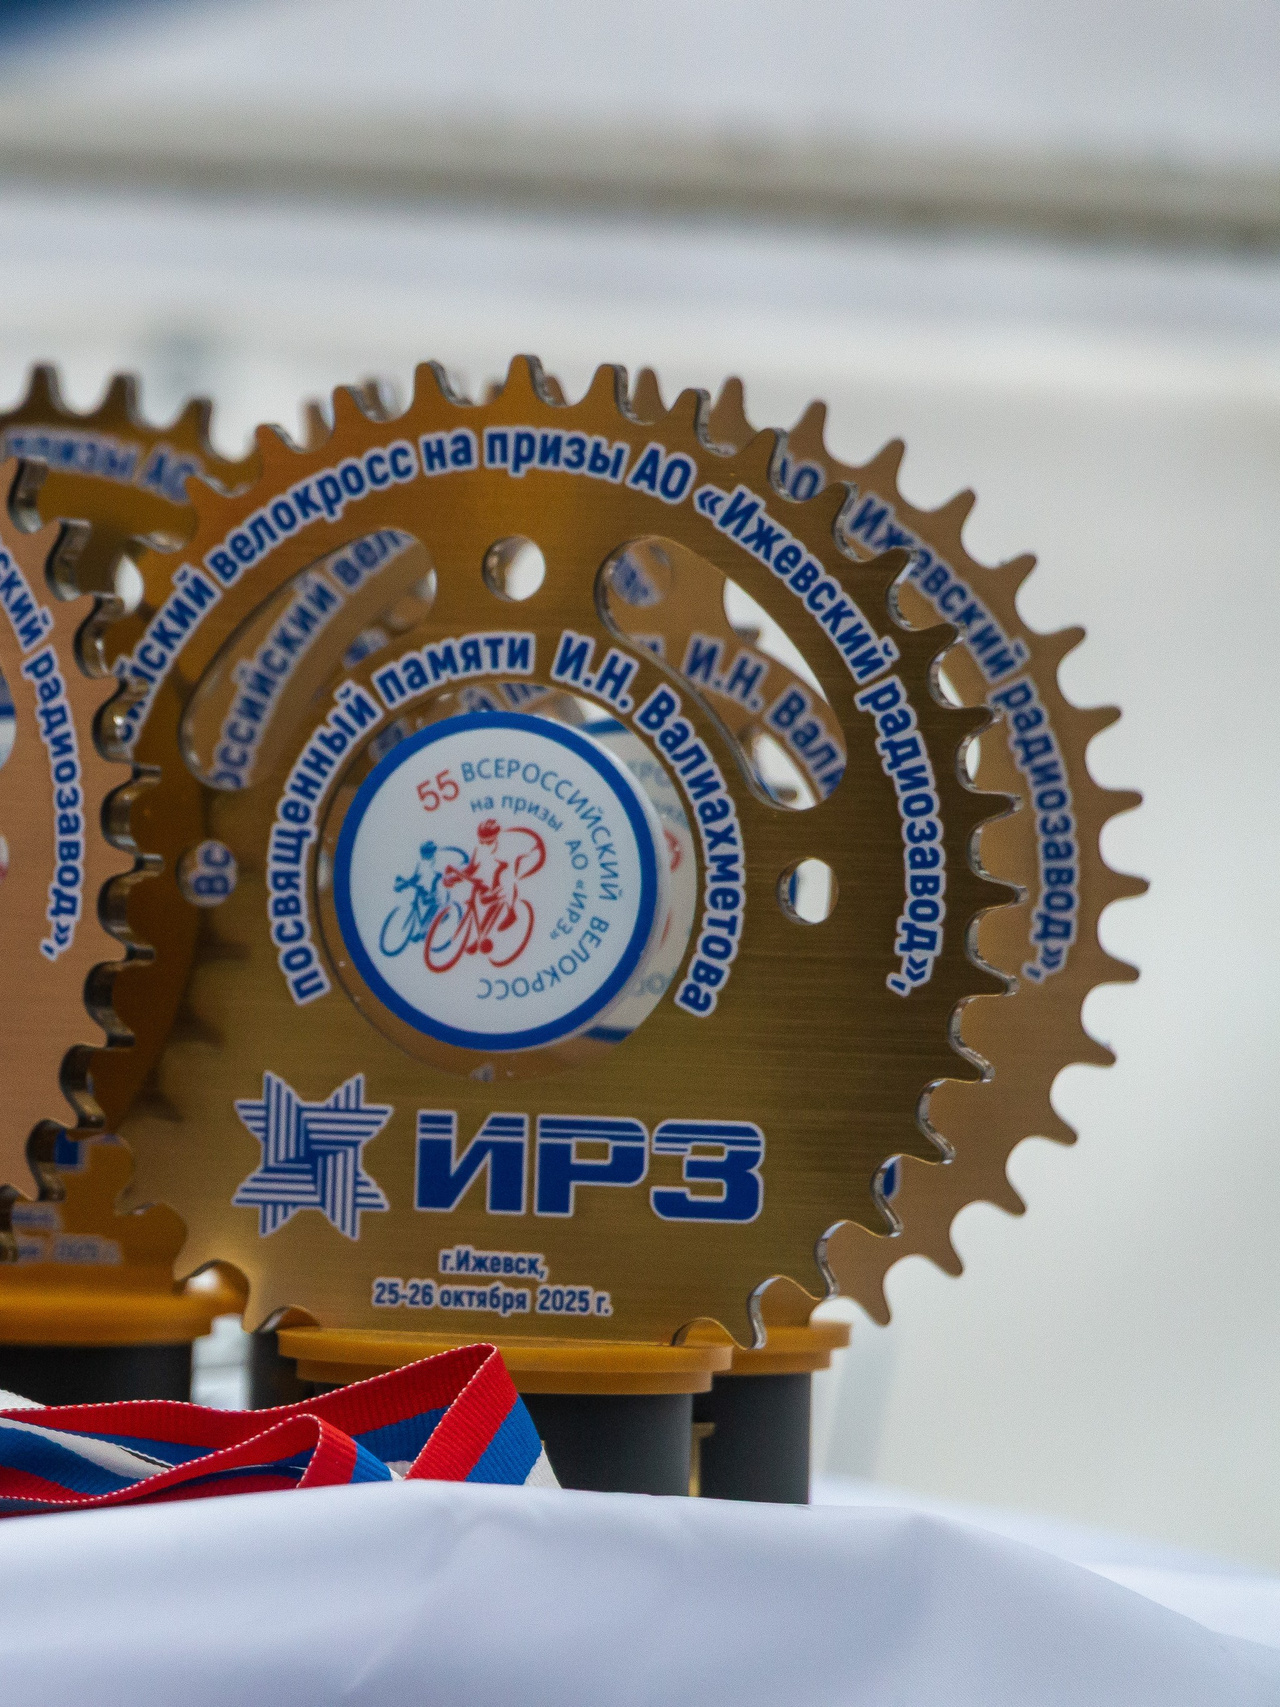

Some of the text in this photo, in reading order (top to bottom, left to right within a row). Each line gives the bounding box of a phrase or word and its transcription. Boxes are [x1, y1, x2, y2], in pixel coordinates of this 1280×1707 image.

[208, 445, 415, 583] велокросс
[422, 432, 474, 473] на
[486, 430, 627, 480] призы
[630, 446, 693, 502] АО
[696, 488, 895, 682] «Ижевский
[856, 678, 942, 993] радиозавод»,
[683, 639, 763, 709] И.Н.
[24, 651, 82, 958] радиозавод»,
[270, 634, 743, 1014] посвященный памяти И.Н. Валиахметова
[416, 769, 460, 813] 55
[460, 757, 623, 901] ВСЕРОССИЙСКИЙ
[471, 796, 495, 814] на
[501, 795, 564, 833] призы
[565, 838, 589, 871] АО
[994, 680, 1076, 980] радиозавод»,
[476, 915, 610, 1001] ВЕЛОКРОСС
[414, 1109, 766, 1225] ИРЗ
[373, 1281, 611, 1315] 25-26 октября 2025 г.
[439, 1249, 548, 1281] г.Ижевск,
